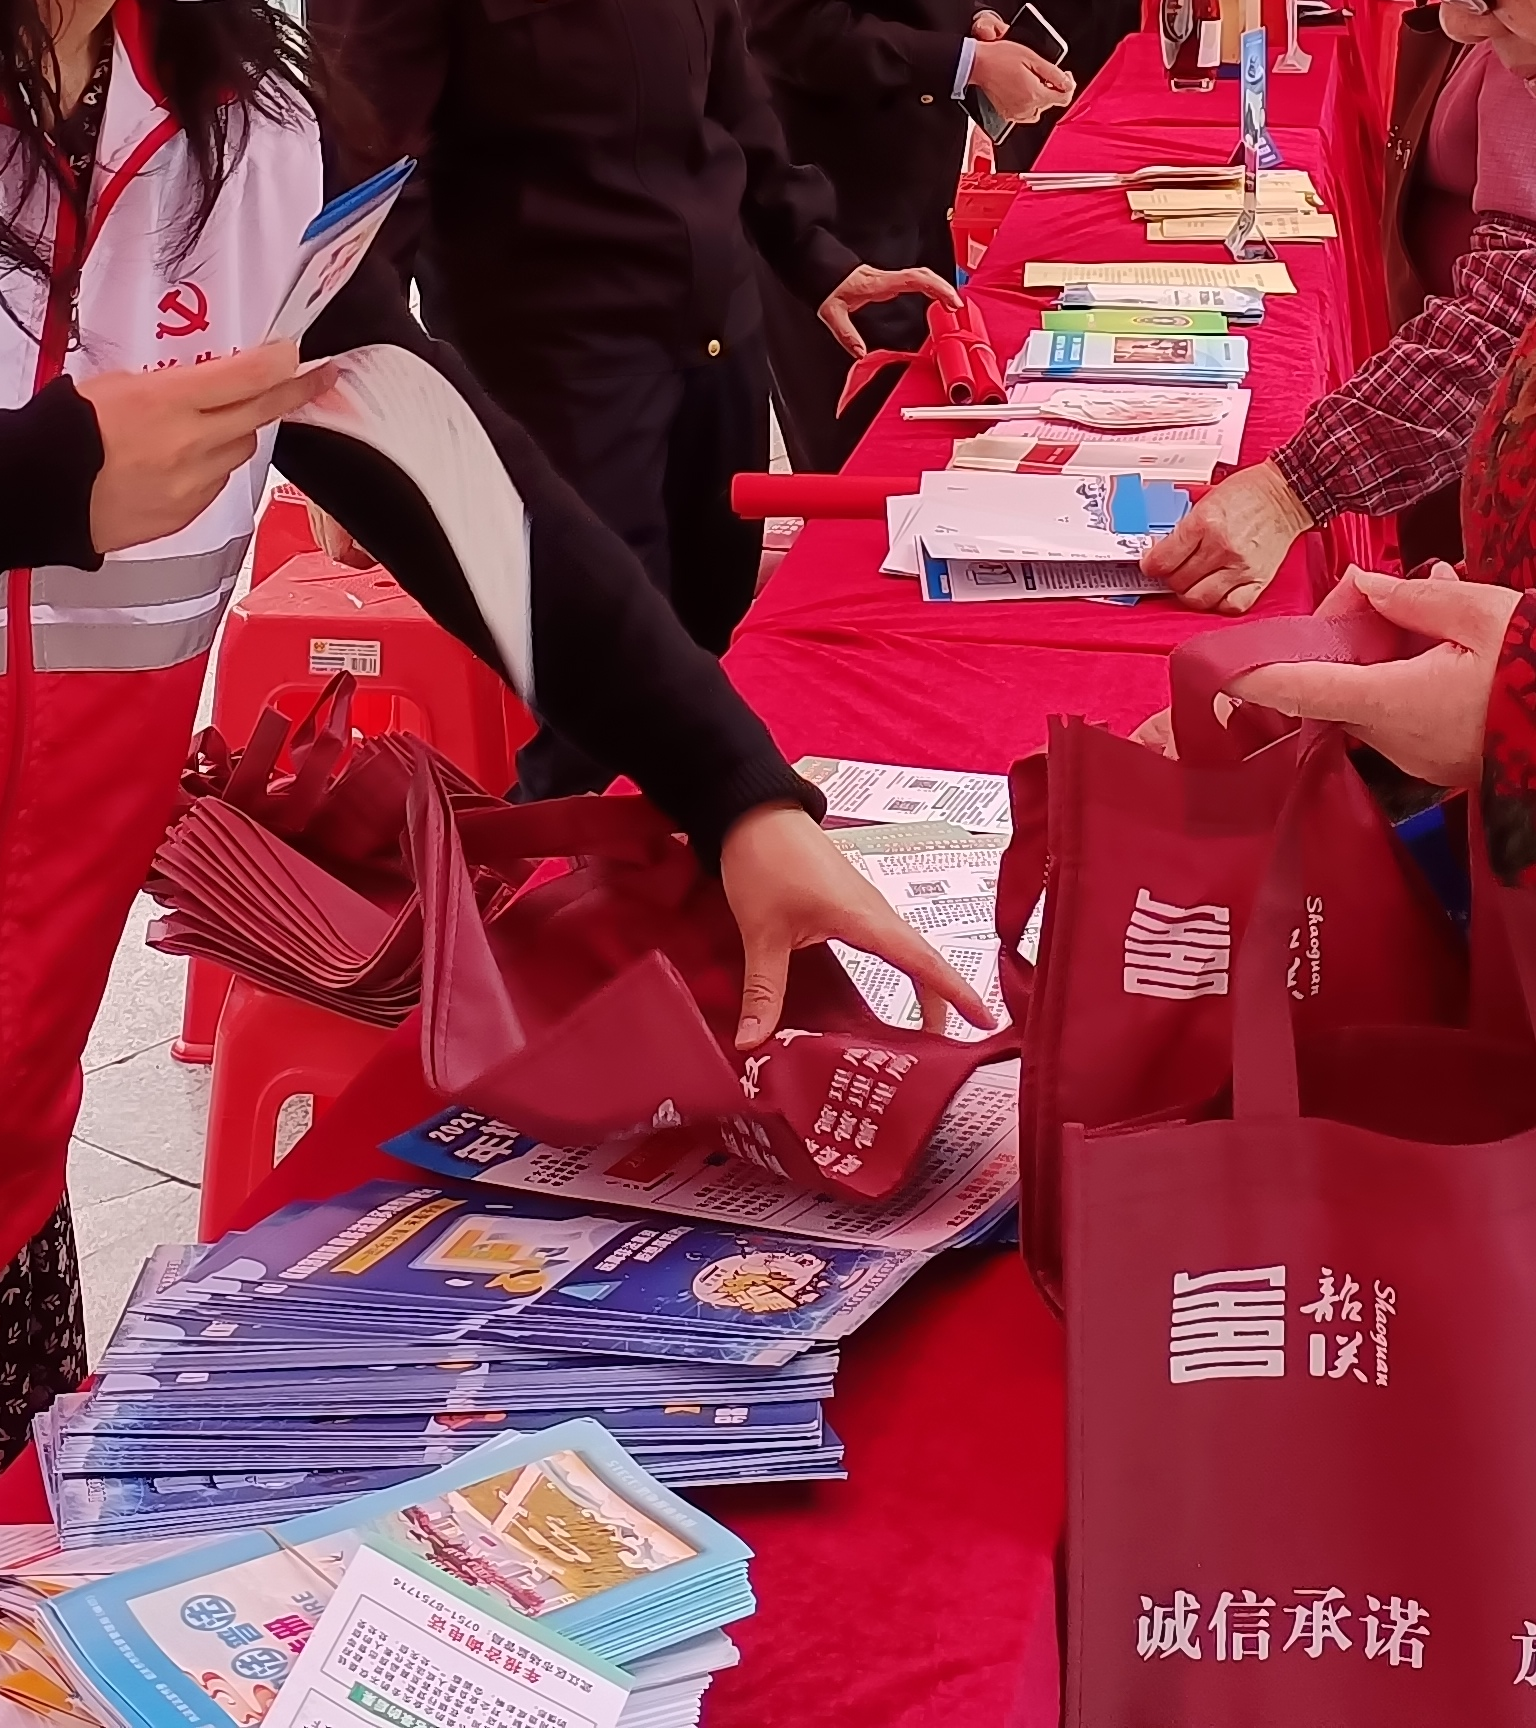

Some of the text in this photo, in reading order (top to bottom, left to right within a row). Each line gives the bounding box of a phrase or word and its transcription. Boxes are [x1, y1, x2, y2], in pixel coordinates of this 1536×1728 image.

[1370, 1279, 1397, 1387] Shaoguan
[432, 1612, 541, 1685] 年报咨询电话
[1135, 1586, 1431, 1669] 诚信承诺
